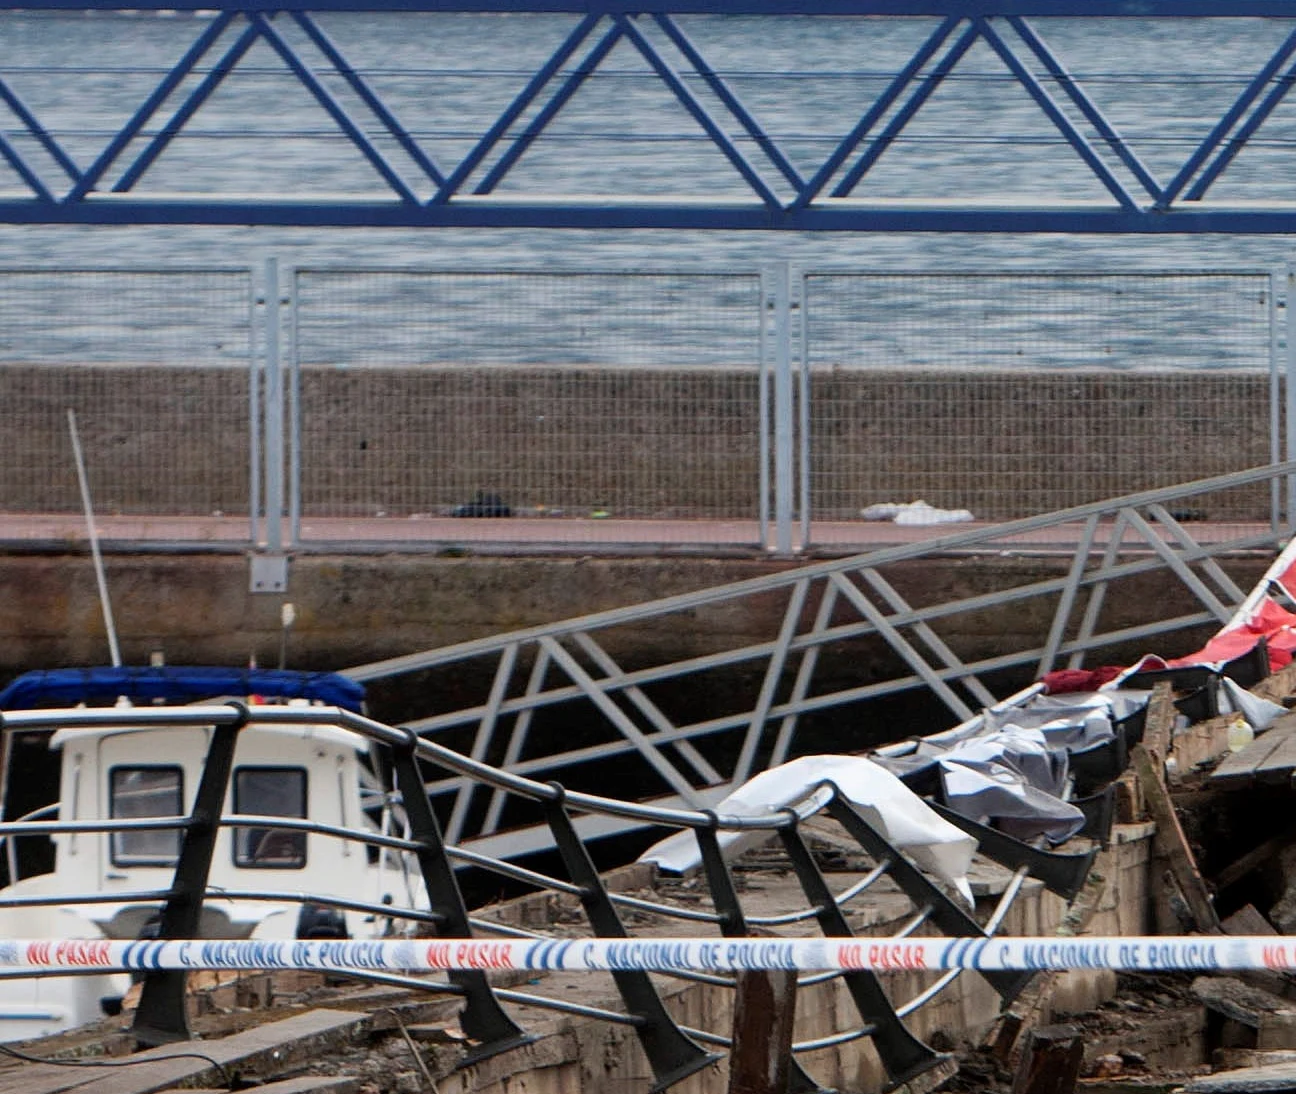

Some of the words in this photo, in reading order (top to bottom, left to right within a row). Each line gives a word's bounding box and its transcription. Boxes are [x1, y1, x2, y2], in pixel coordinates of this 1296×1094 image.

[26, 941, 52, 966] NO
[55, 941, 112, 966] PASAR
[201, 941, 289, 967] NACIONAL
[291, 941, 316, 967] DE
[426, 943, 452, 968] NO
[456, 943, 514, 968] PASAR
[605, 943, 696, 969] NACIONAL
[699, 943, 726, 969] DE
